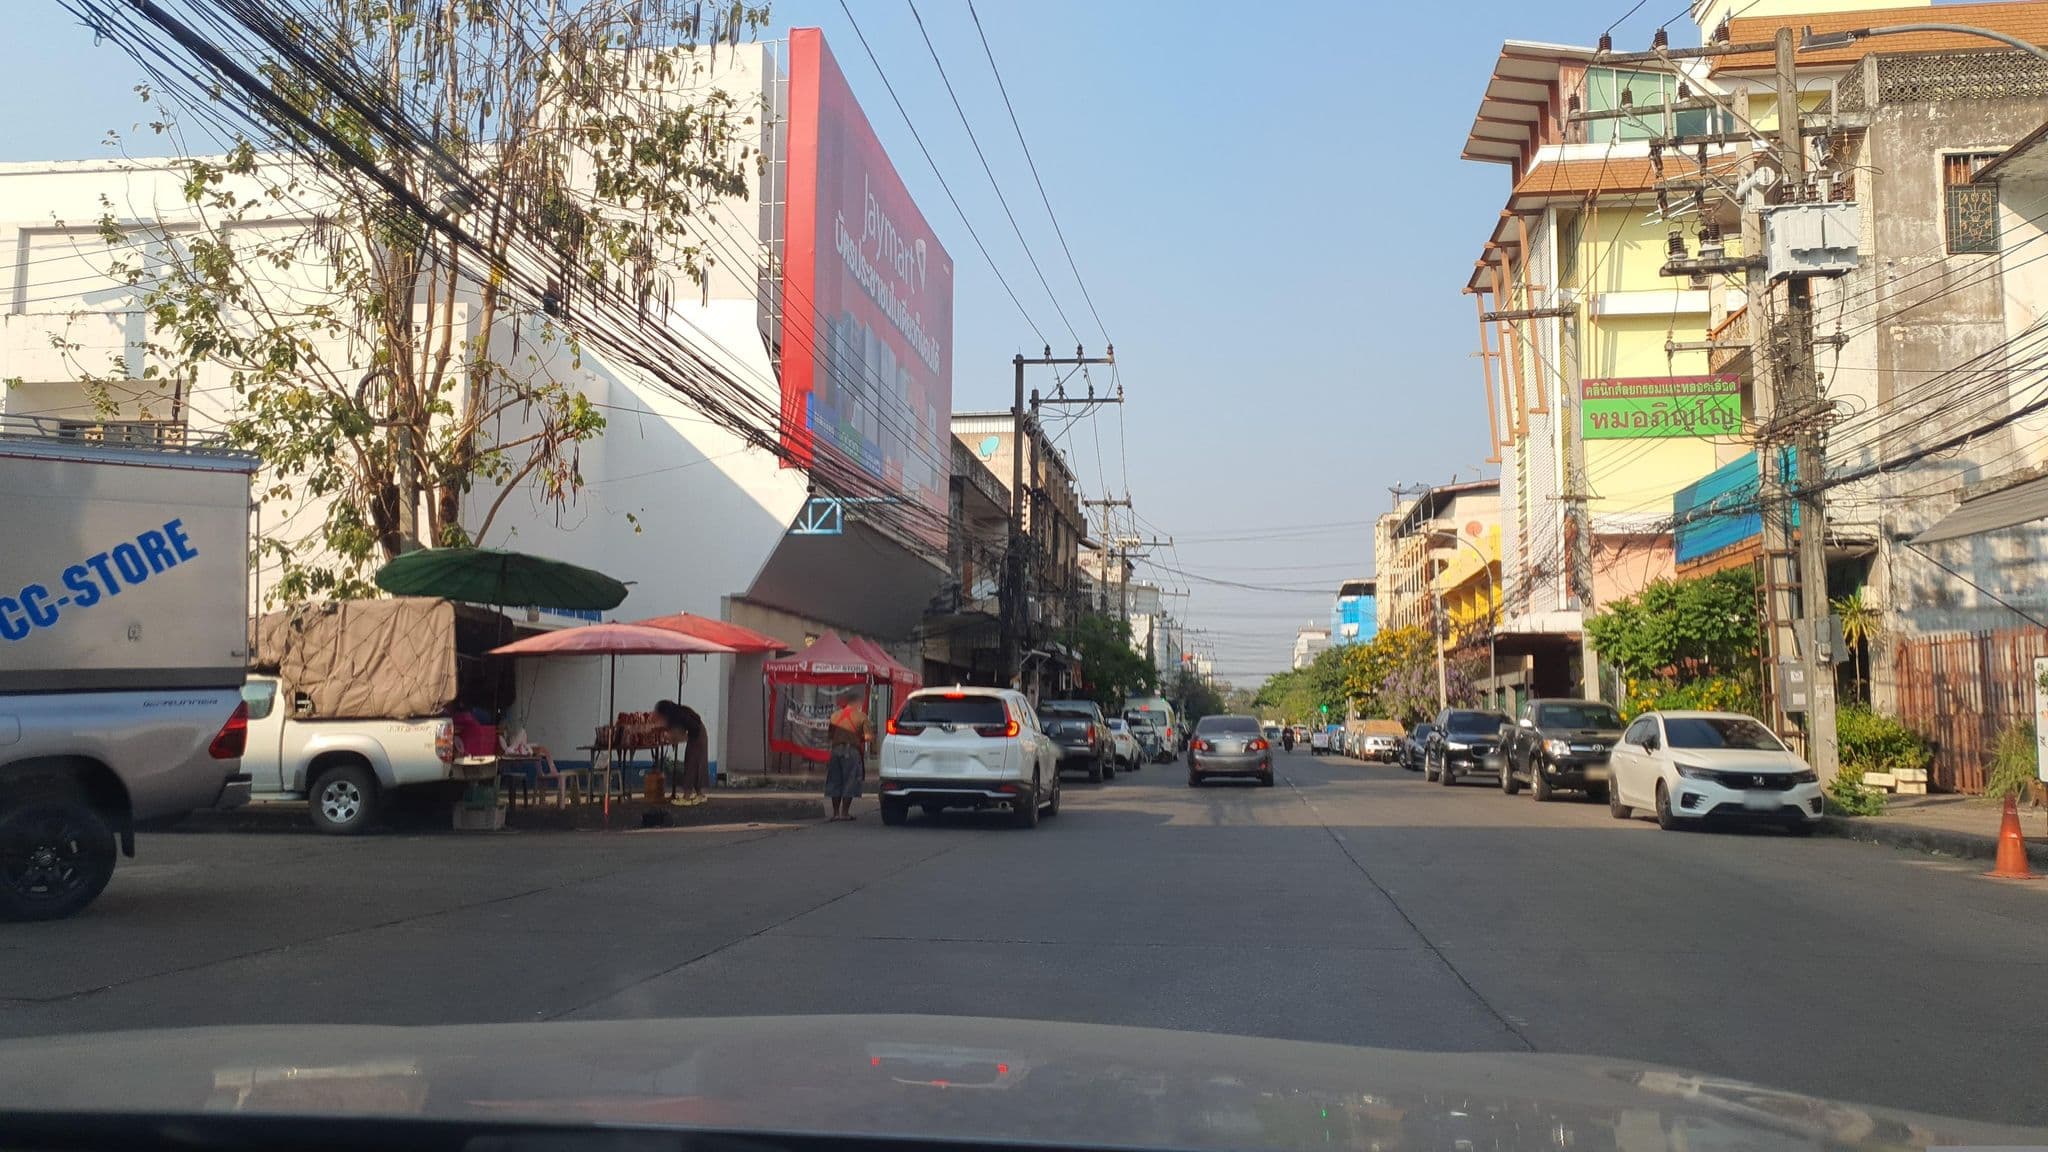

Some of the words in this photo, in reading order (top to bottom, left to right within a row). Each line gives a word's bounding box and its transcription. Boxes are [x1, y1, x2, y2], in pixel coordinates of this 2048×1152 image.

[862, 172, 915, 295] Jaymart
[1589, 399, 1735, 432] หมอภิญโญ
